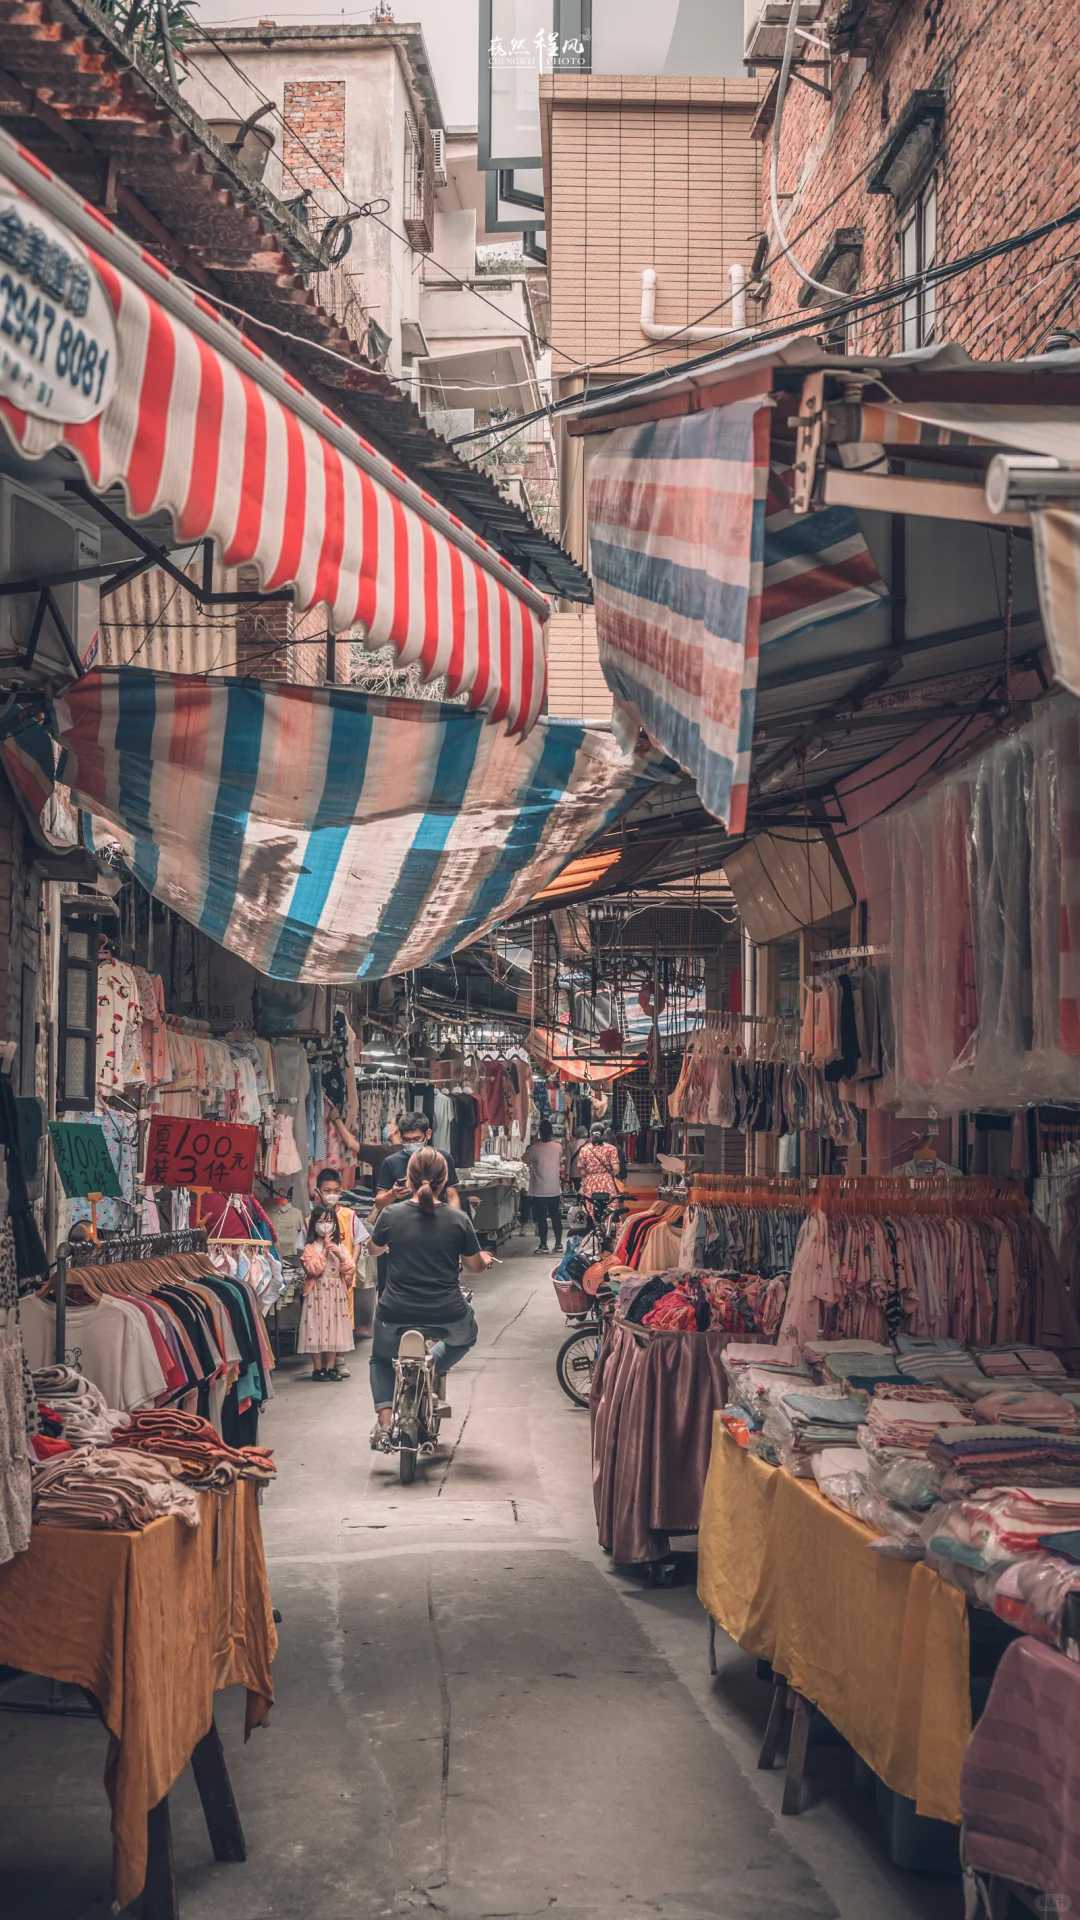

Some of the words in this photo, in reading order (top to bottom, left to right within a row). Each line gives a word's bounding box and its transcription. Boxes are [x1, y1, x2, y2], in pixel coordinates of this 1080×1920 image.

[55, 318, 109, 404] 8081
[85, 546, 99, 560] GREE
[150, 1123, 173, 1184] 夏装
[79, 1168, 109, 1197] 3件
[174, 1155, 230, 1184] 3件
